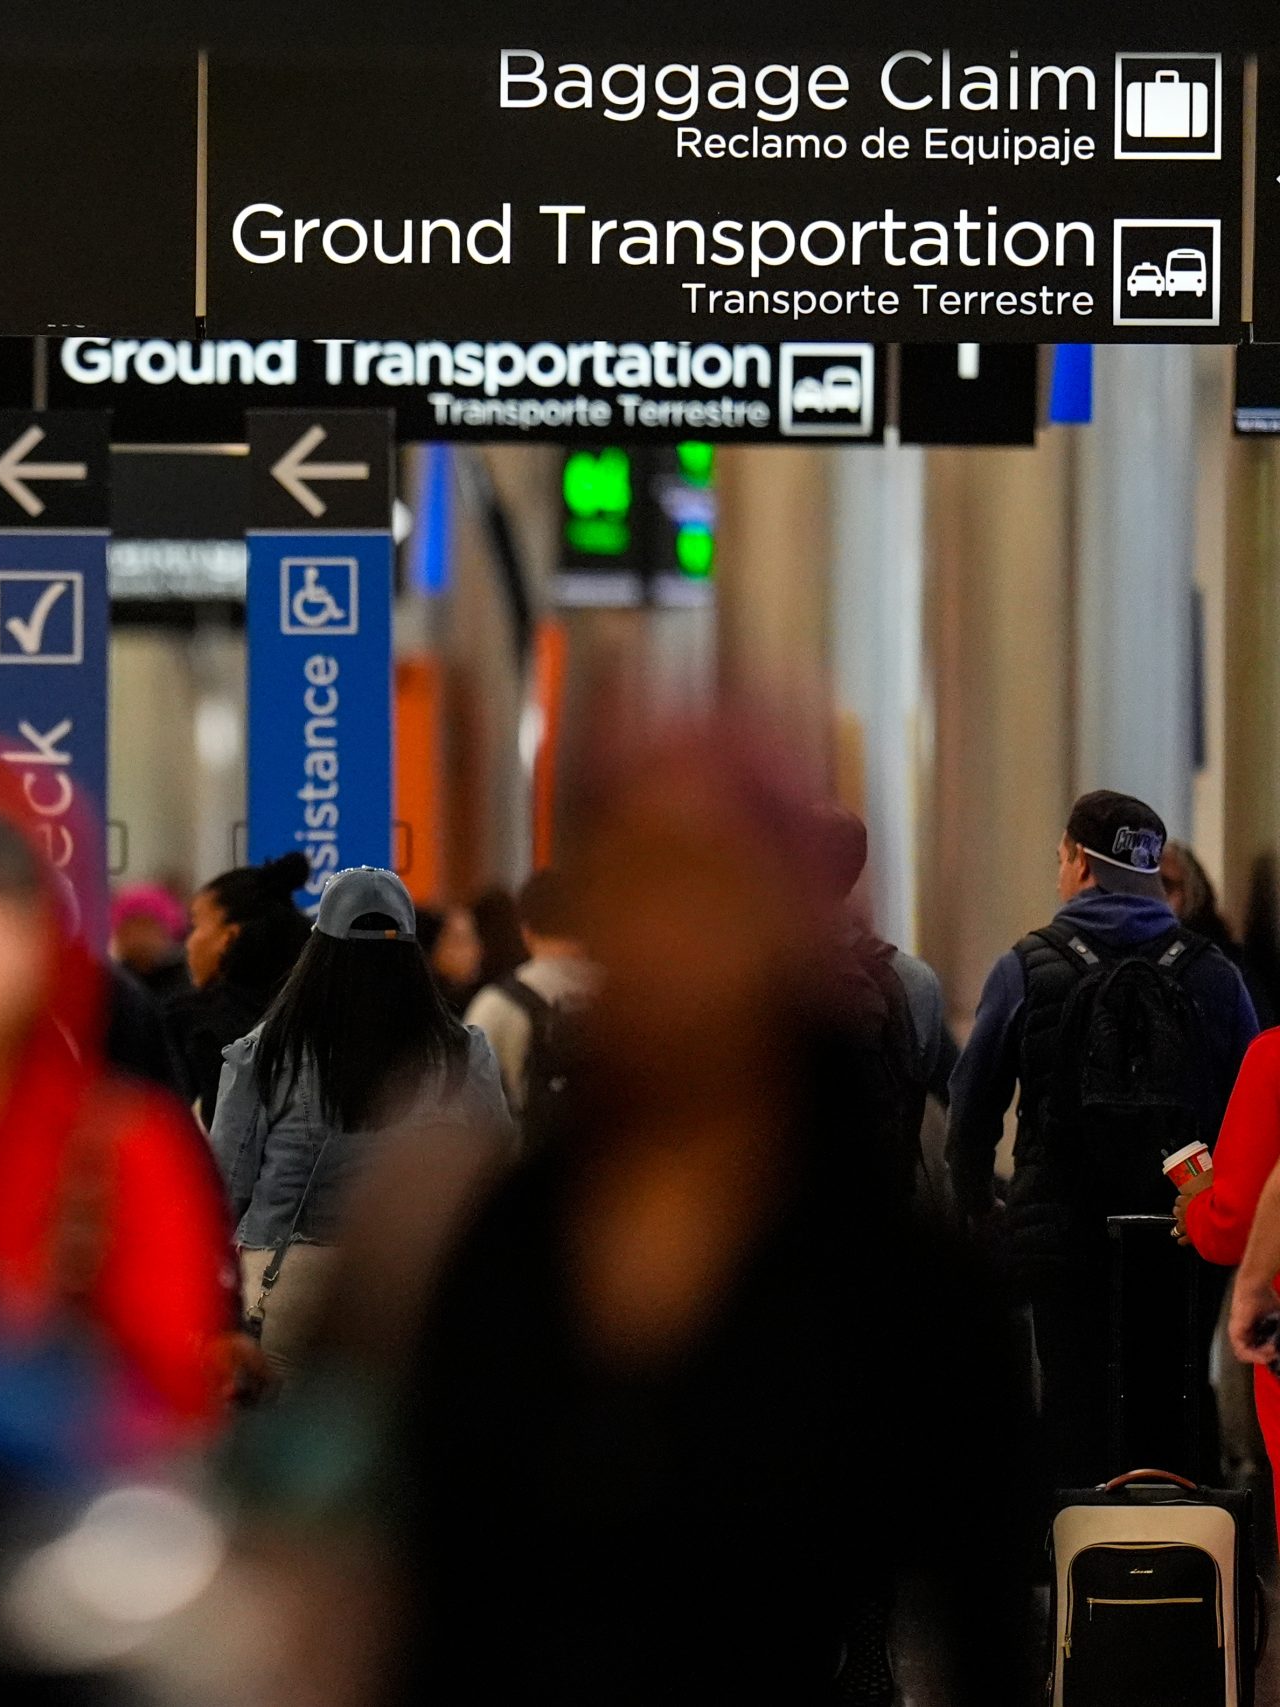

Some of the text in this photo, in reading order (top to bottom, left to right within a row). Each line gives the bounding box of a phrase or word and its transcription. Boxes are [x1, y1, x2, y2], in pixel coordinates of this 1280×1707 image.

[498, 48, 1096, 123] Baggage Claim
[676, 125, 1096, 166] Reclamo de Equipaje
[231, 202, 1095, 276] Ground Transportation
[681, 282, 1094, 319] Transporte Terrestre
[61, 337, 771, 396] Ground Transportation
[427, 392, 771, 431] Transporte Terrestre
